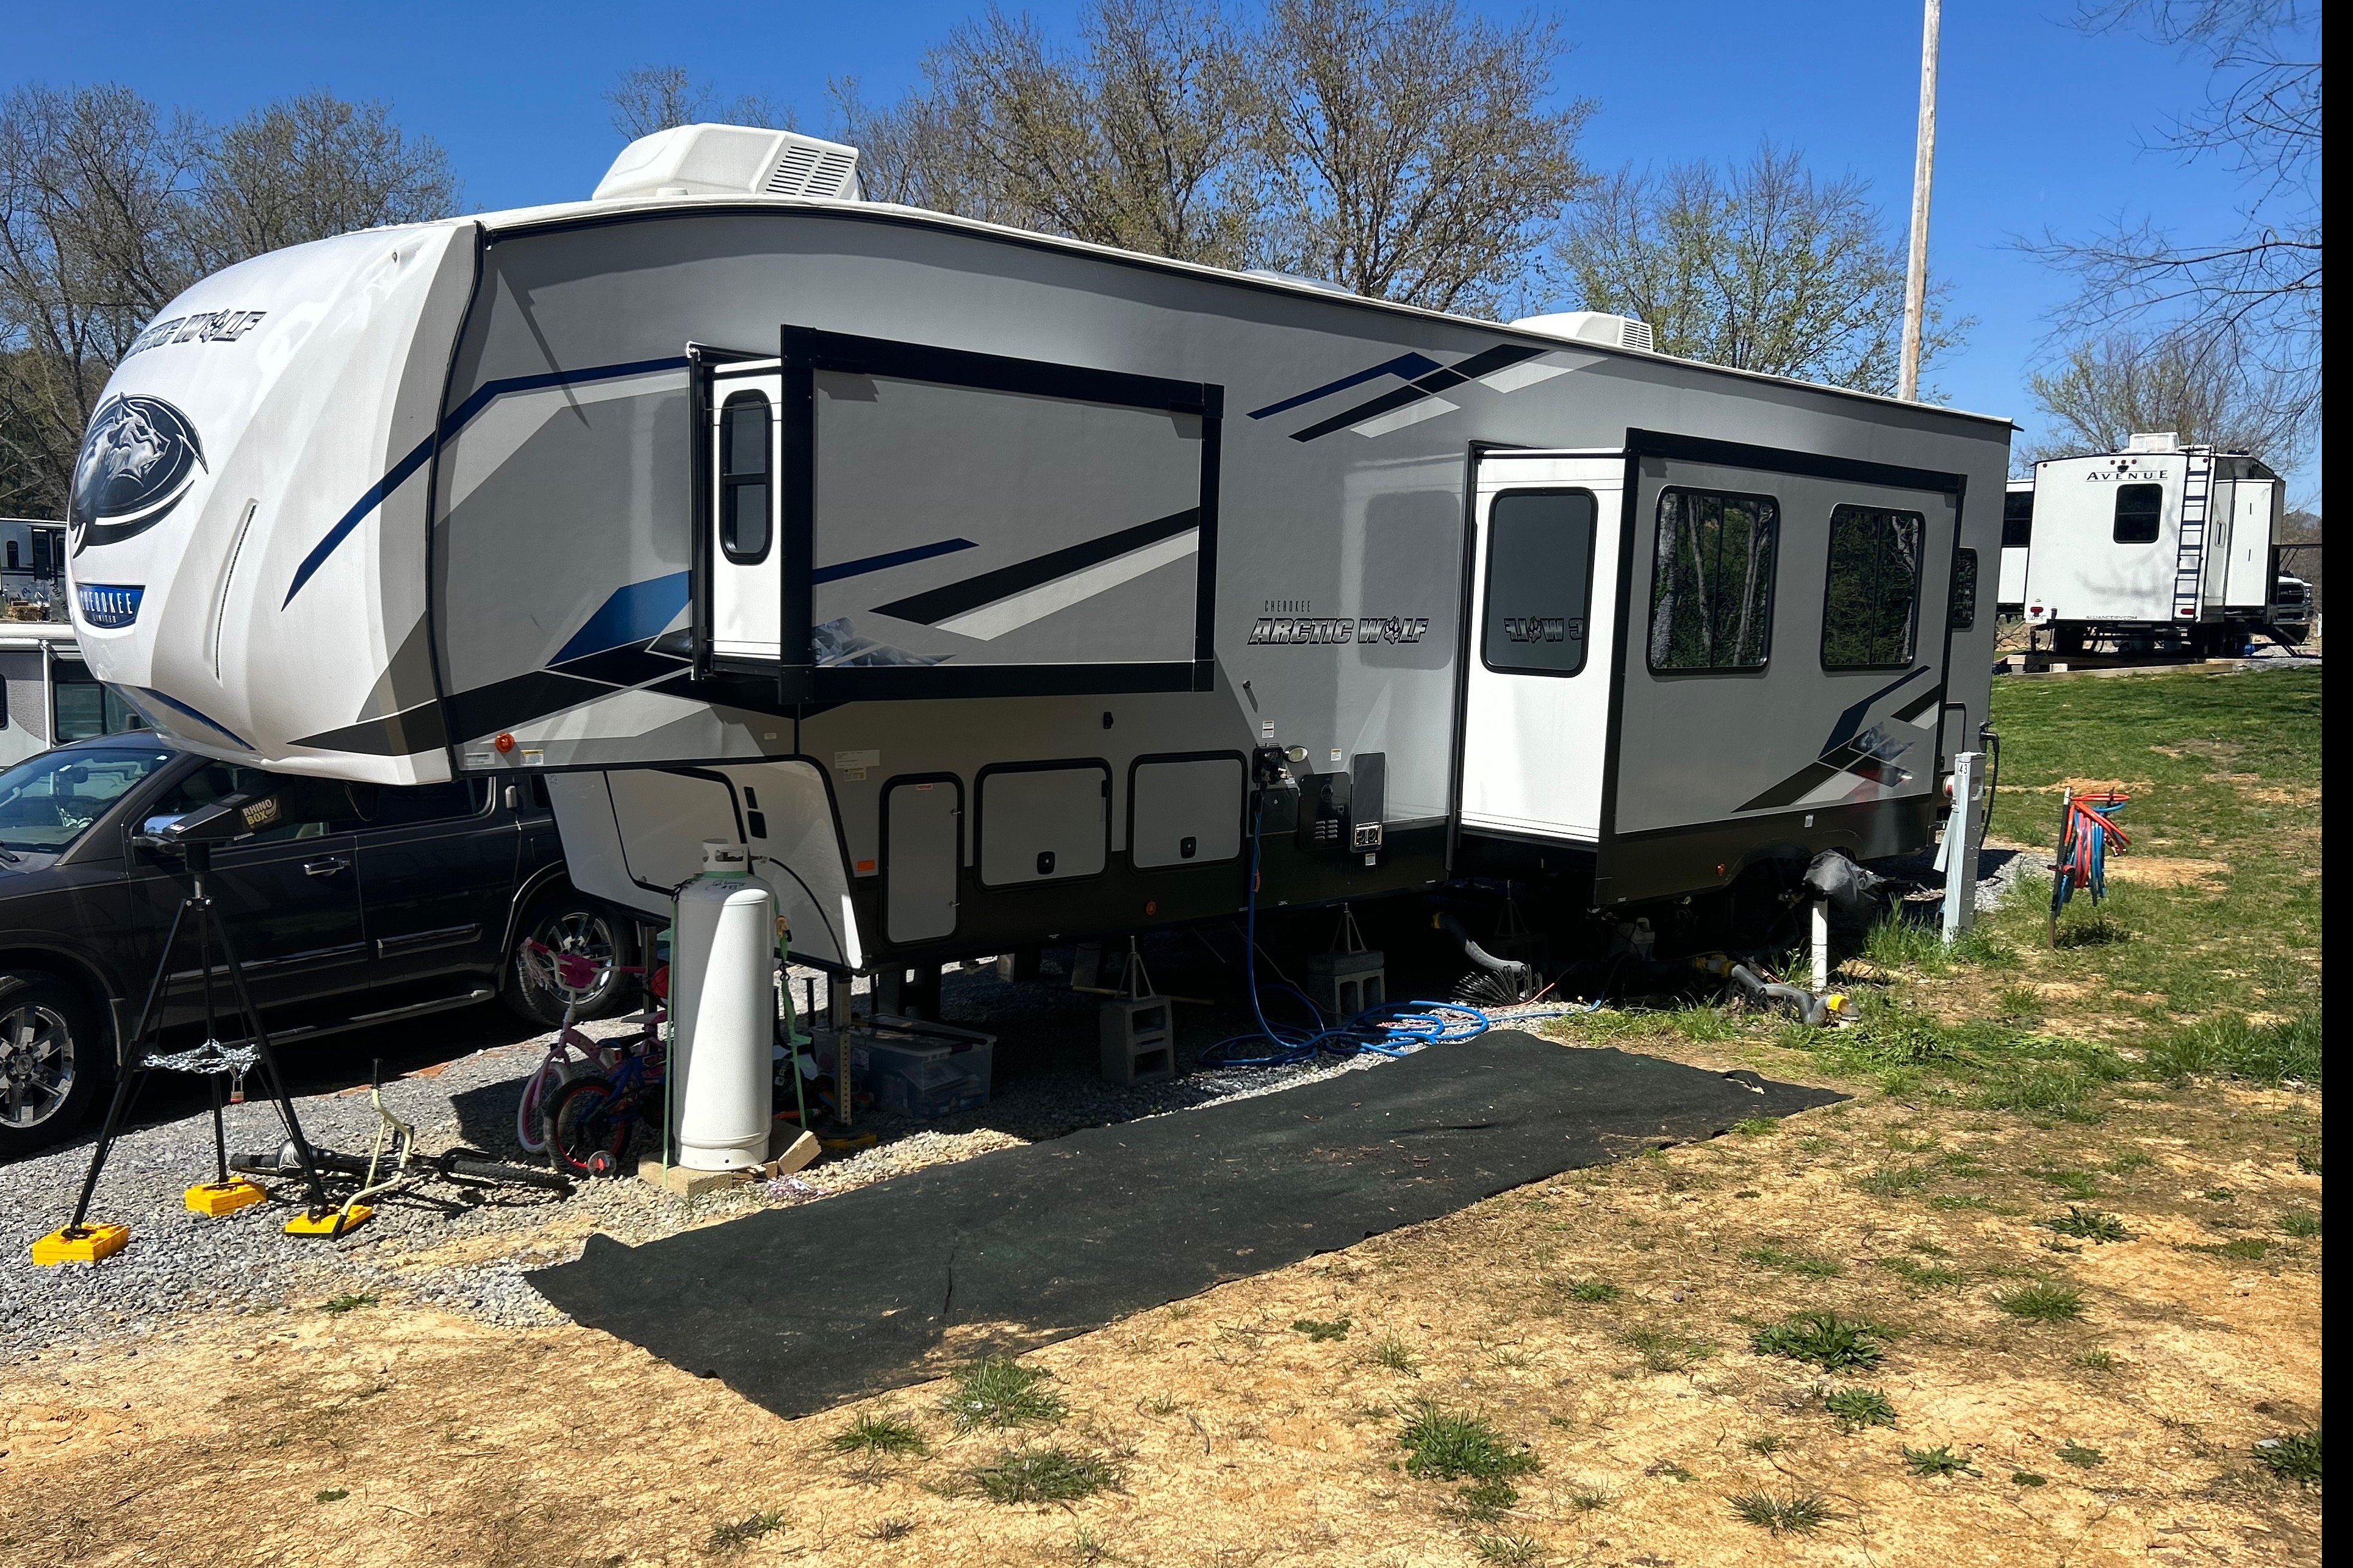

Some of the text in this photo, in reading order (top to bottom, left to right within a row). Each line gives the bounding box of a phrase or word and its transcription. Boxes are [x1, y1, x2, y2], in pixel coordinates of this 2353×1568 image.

[2086, 470, 2168, 481] AVENUE
[80, 590, 133, 614] CHEROKEE
[1265, 600, 1310, 612] CHEROKEE
[1247, 617, 1354, 645] ARCTIC
[1959, 764, 1967, 775] 43
[242, 799, 273, 817] RHINO
[246, 810, 268, 825] BOX
